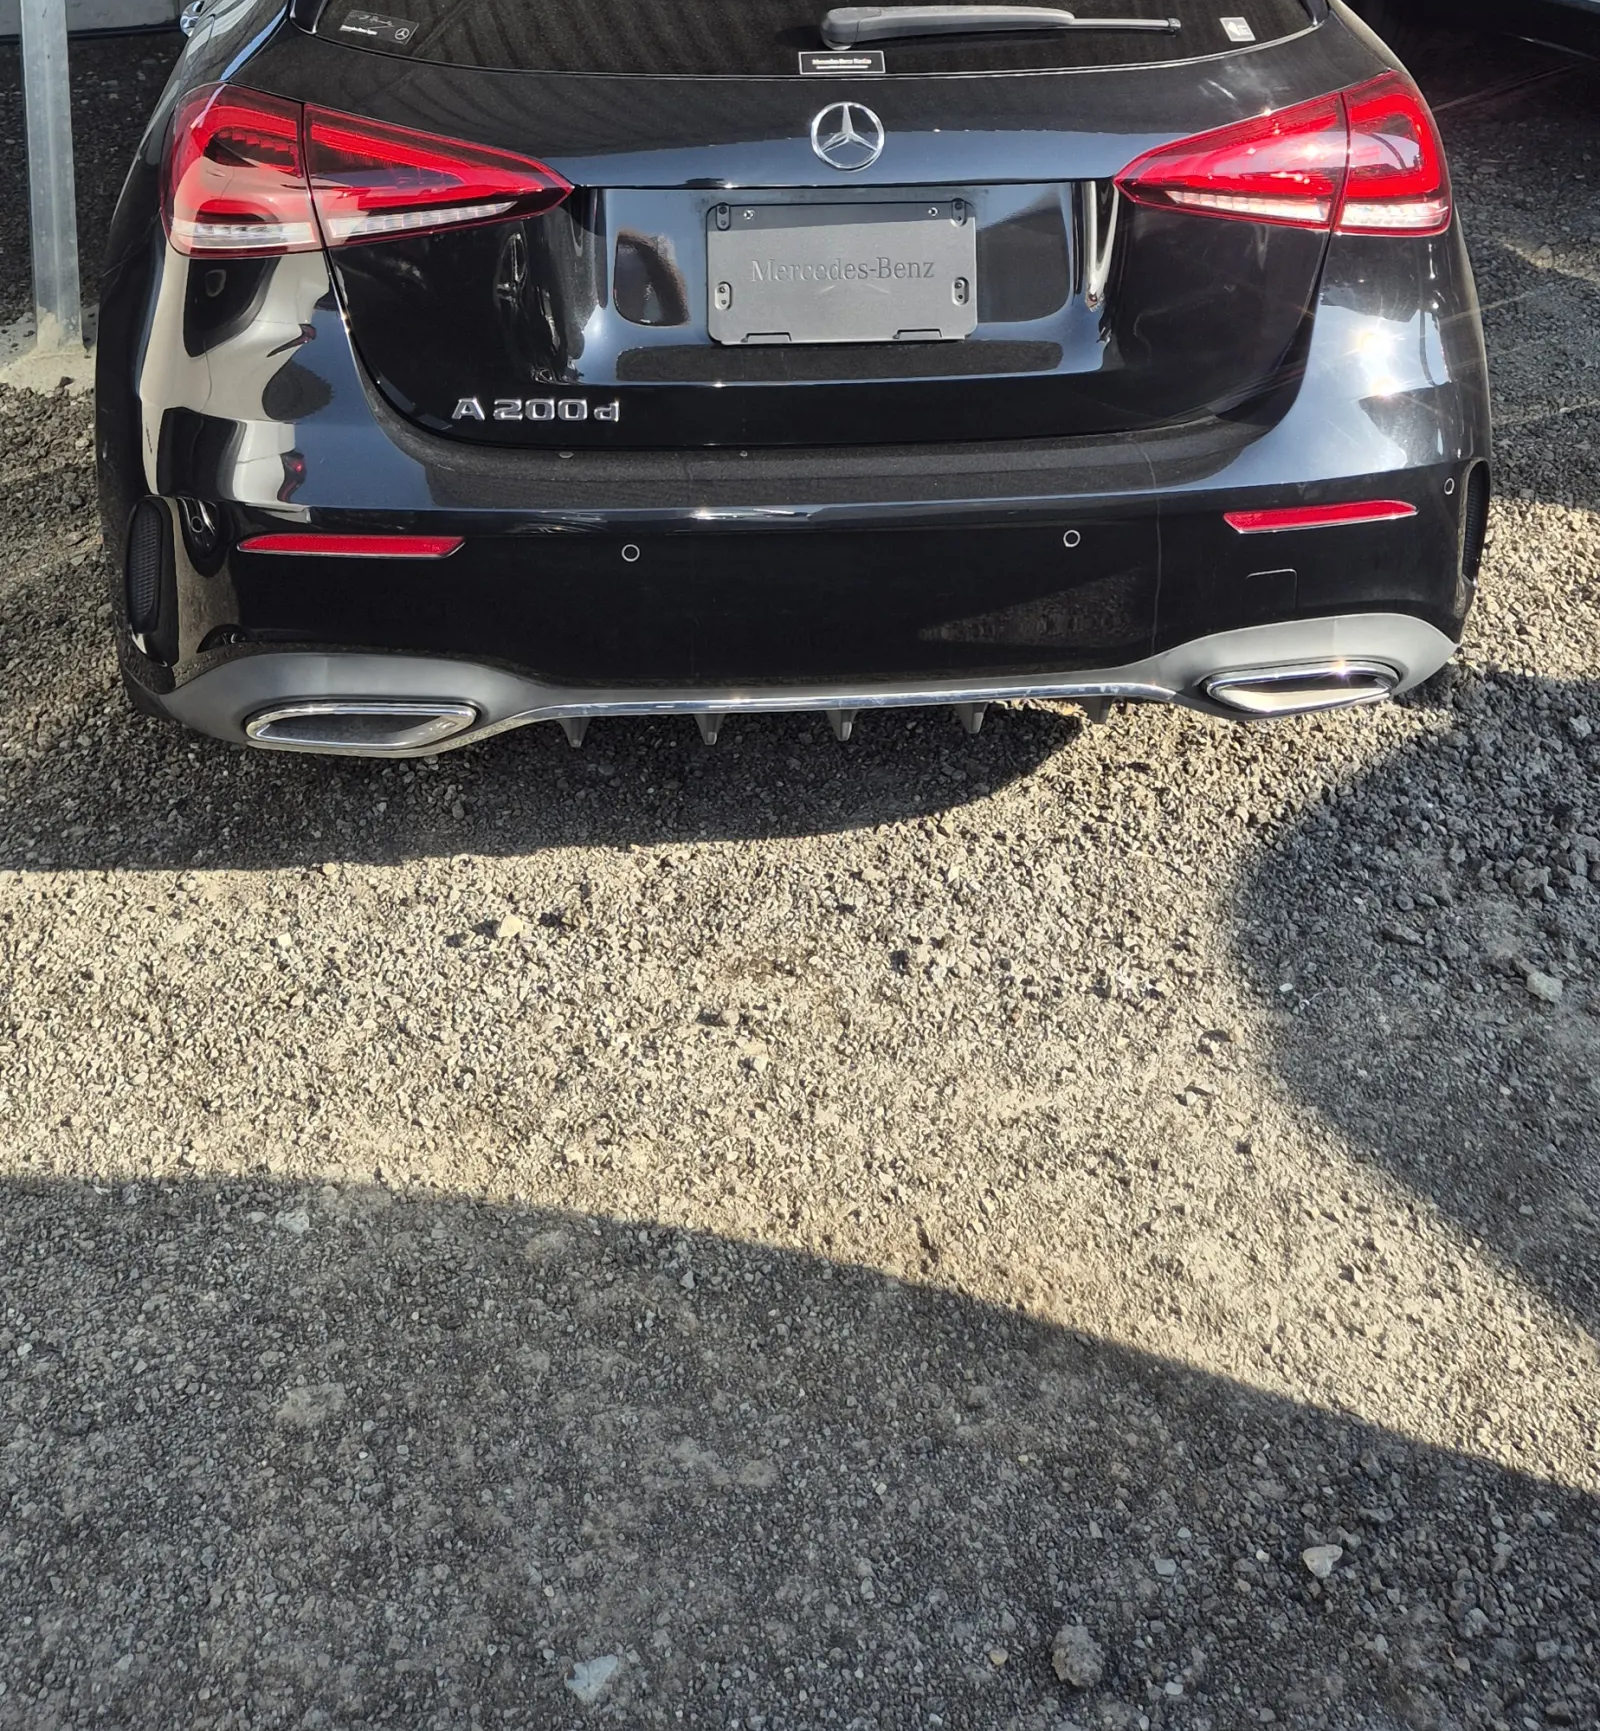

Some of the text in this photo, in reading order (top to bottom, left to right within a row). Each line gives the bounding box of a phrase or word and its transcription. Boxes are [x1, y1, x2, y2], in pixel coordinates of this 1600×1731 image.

[751, 257, 935, 283] Mercedes-Benz
[451, 397, 620, 422] A 200 d
